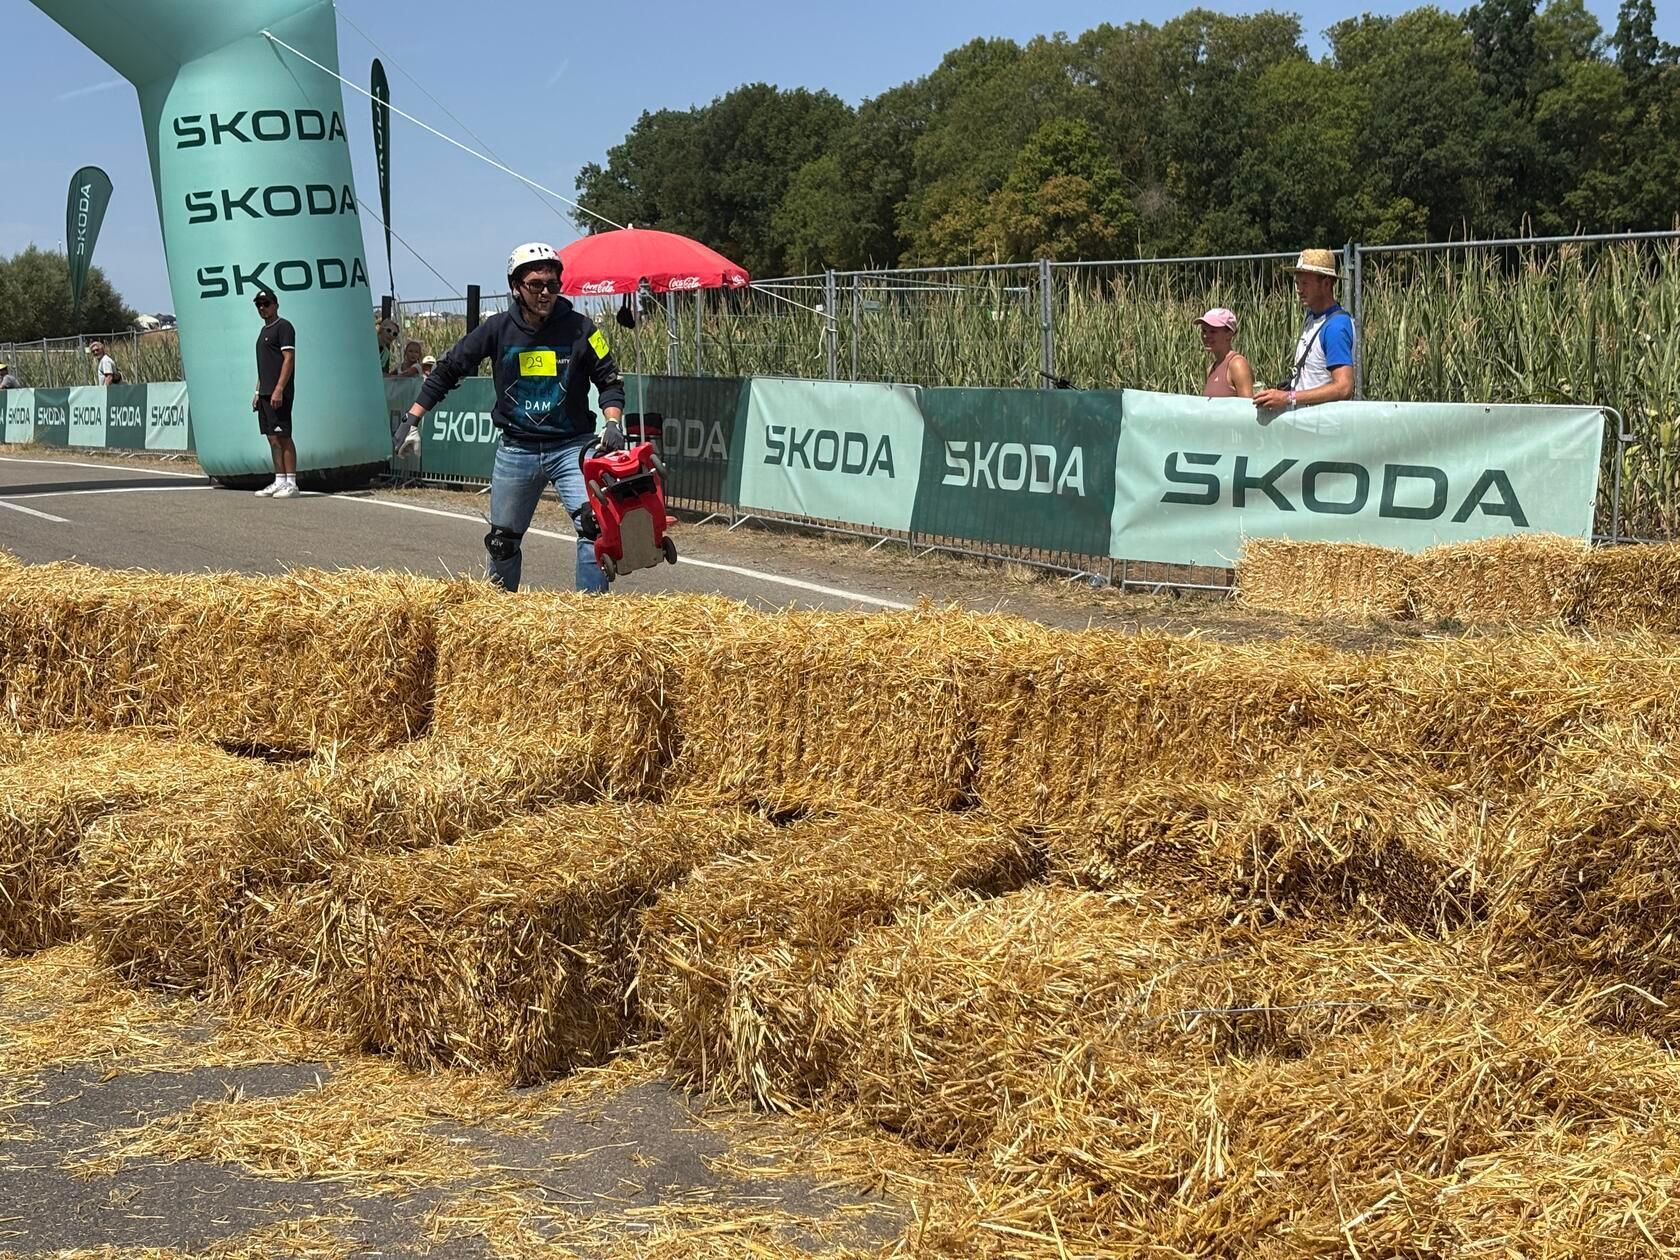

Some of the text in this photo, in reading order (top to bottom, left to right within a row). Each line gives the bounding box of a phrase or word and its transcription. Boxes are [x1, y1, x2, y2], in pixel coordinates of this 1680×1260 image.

[527, 356, 543, 369] 29
[525, 400, 551, 411] DAM
[651, 418, 728, 460] ODA
